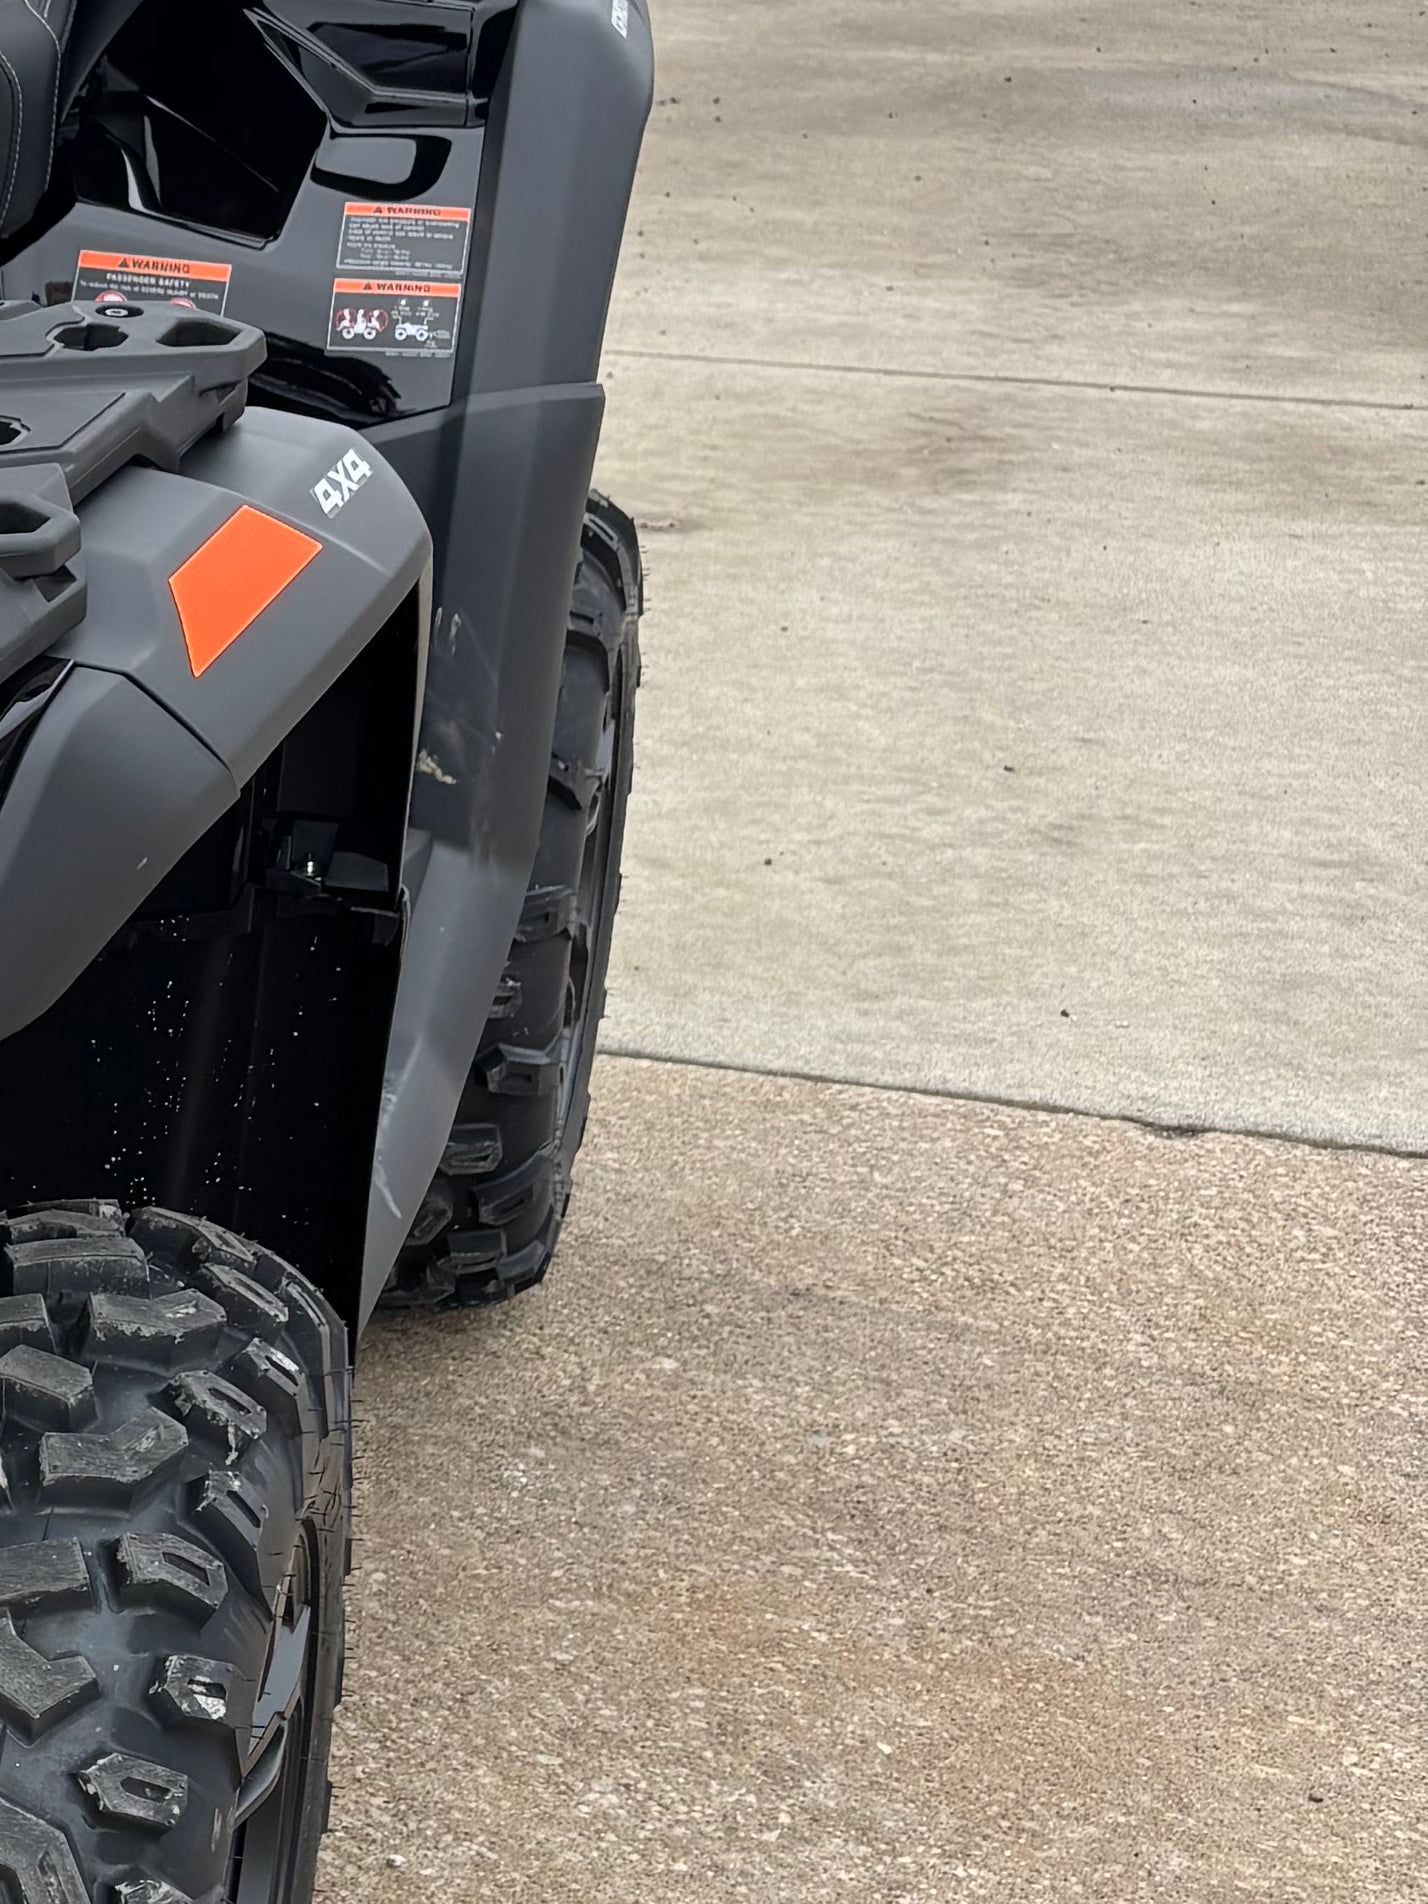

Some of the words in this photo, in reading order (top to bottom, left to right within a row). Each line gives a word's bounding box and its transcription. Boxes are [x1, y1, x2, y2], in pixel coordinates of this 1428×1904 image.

[387, 206, 442, 217] WARNING
[132, 257, 191, 274] WARNING
[106, 273, 156, 285] PASSENGER
[158, 276, 190, 288] SAFETY
[376, 283, 431, 293] WARNING
[314, 449, 373, 514] 4X4
